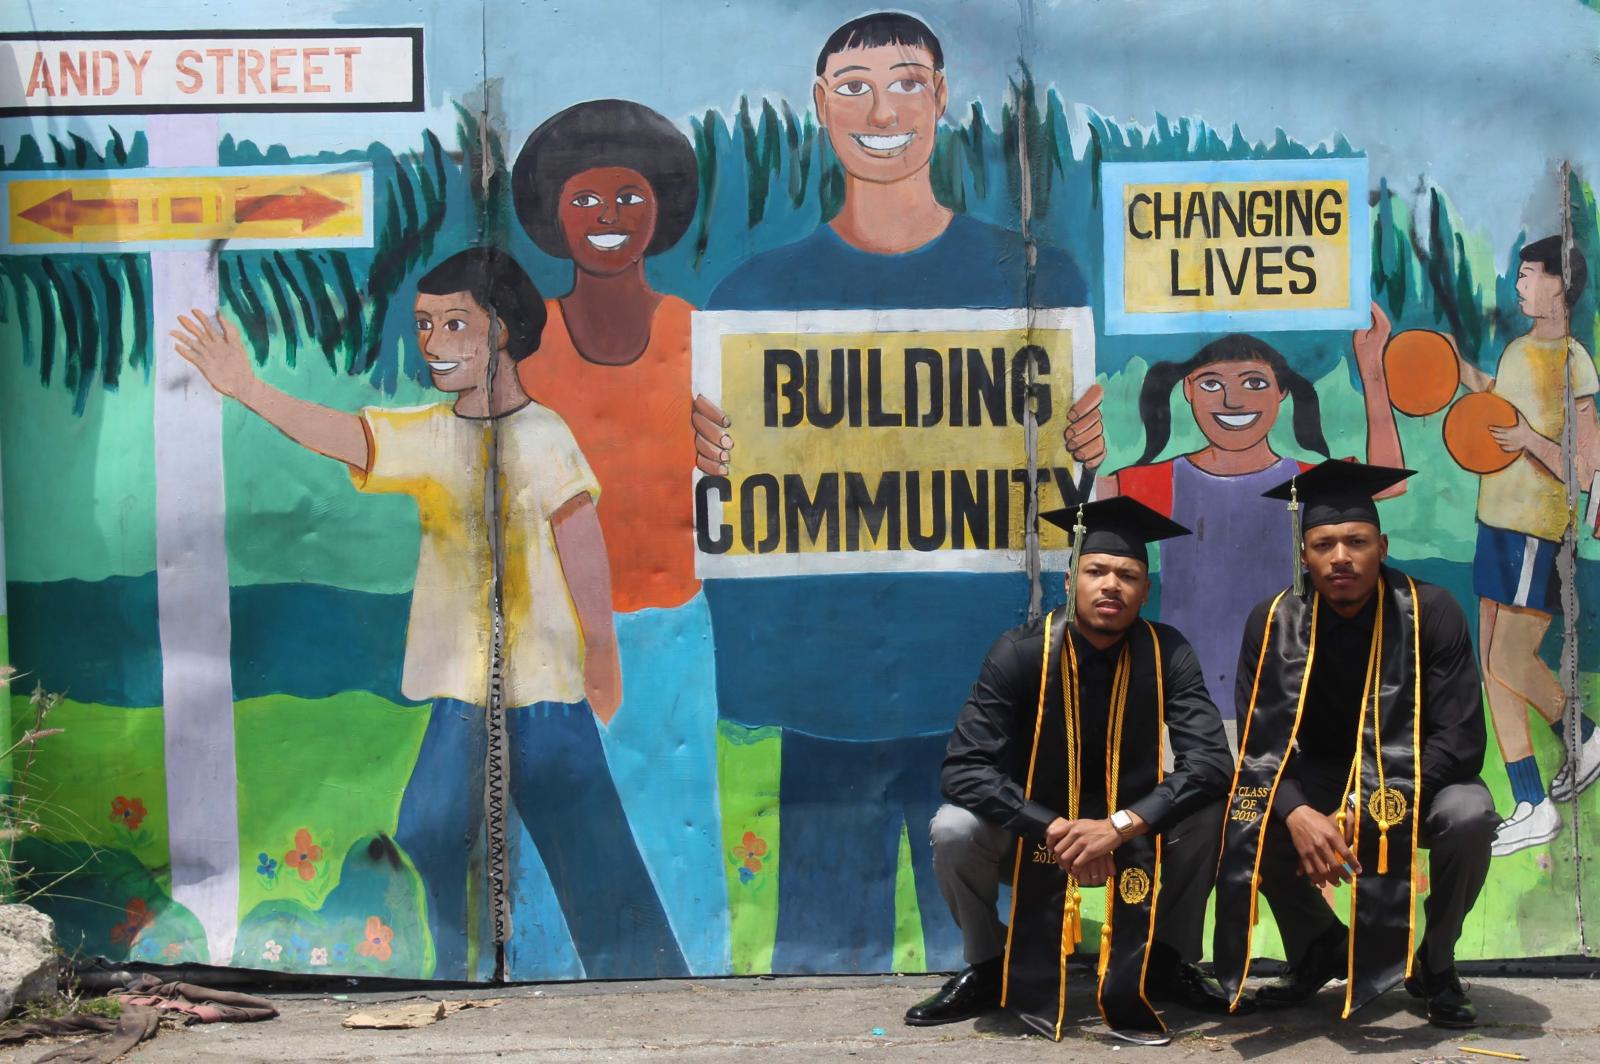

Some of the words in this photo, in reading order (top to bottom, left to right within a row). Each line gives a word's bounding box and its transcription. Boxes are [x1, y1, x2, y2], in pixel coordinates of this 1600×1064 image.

[26, 49, 152, 97] ANDY
[175, 46, 362, 95] STREET
[1128, 188, 1343, 240] CHANGING
[1170, 245, 1317, 296] LIVES
[763, 345, 1053, 428] BUILDING
[695, 467, 1097, 554] COMMUNITY
[1231, 810, 1257, 822] 2019
[1238, 786, 1268, 798] CLASS
[1240, 799, 1257, 810] OF
